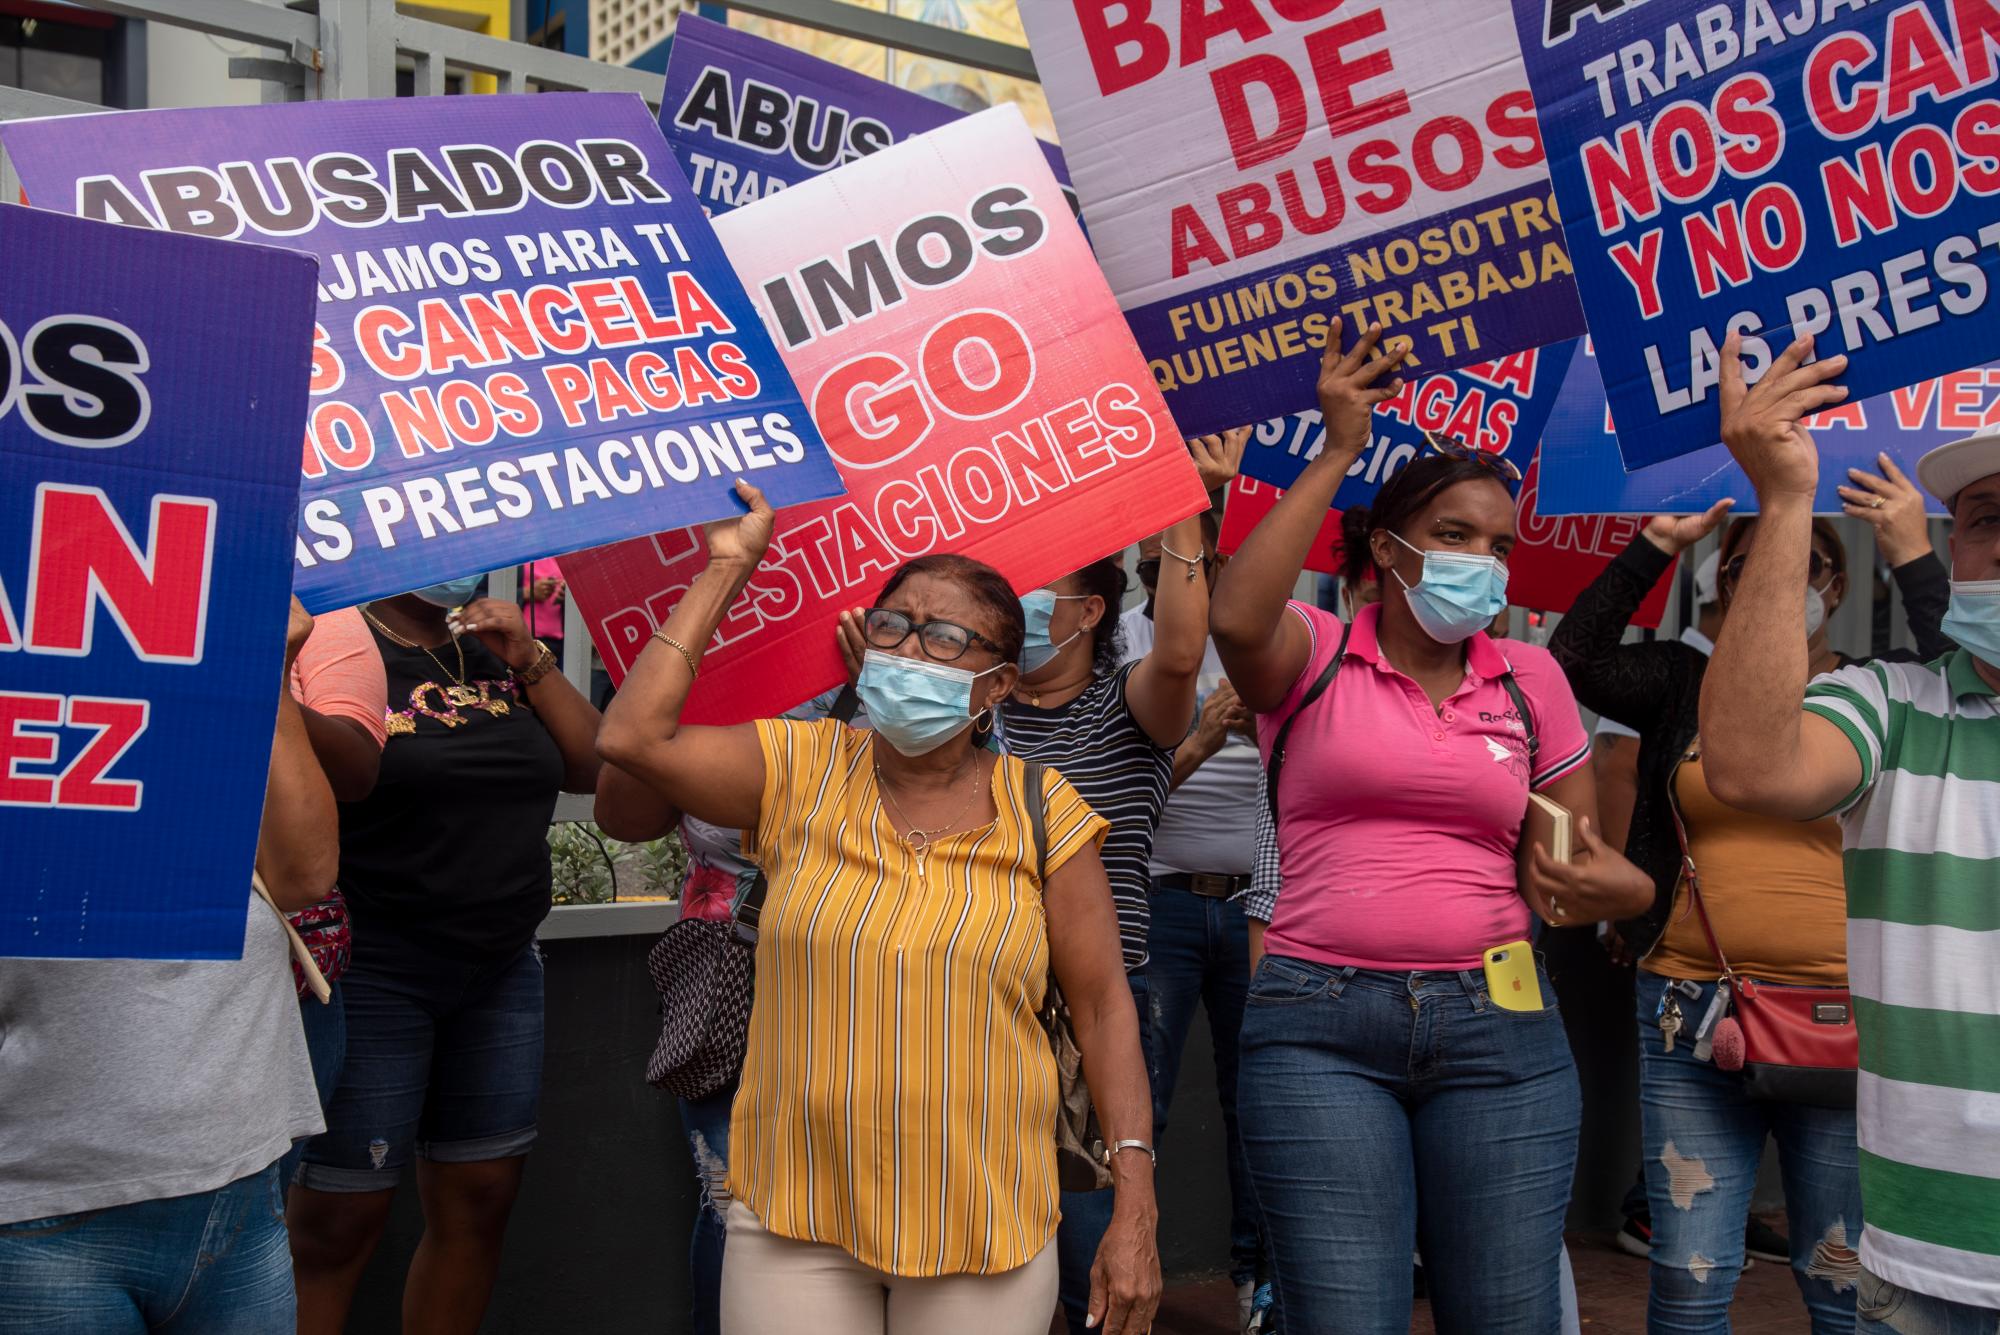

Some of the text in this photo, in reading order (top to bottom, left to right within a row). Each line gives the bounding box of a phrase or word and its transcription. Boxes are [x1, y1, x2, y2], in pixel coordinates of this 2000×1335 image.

[1072, 0, 1347, 97] BA
[1209, 8, 1411, 171] DE
[76, 138, 672, 242] ABUSADOR
[1171, 90, 1546, 279] ABUSOS
[1580, 72, 1786, 236] NOS
[1608, 98, 2000, 320] Y NO NOS
[318, 223, 691, 303] JAMOS PARA TI
[354, 270, 736, 381] CANCELA
[760, 185, 1049, 350] IMOS
[1148, 312, 1331, 392] QUIENES
[1341, 240, 1574, 336] TRABAJA
[1169, 263, 1338, 341] FUIMOS
[811, 307, 1037, 470] GO
[1427, 314, 1481, 358] TI
[1643, 311, 1773, 415] LAS
[381, 372, 543, 458] NOS
[542, 341, 761, 428] PAGAS
[361, 412, 805, 548] PRESTACIONES
